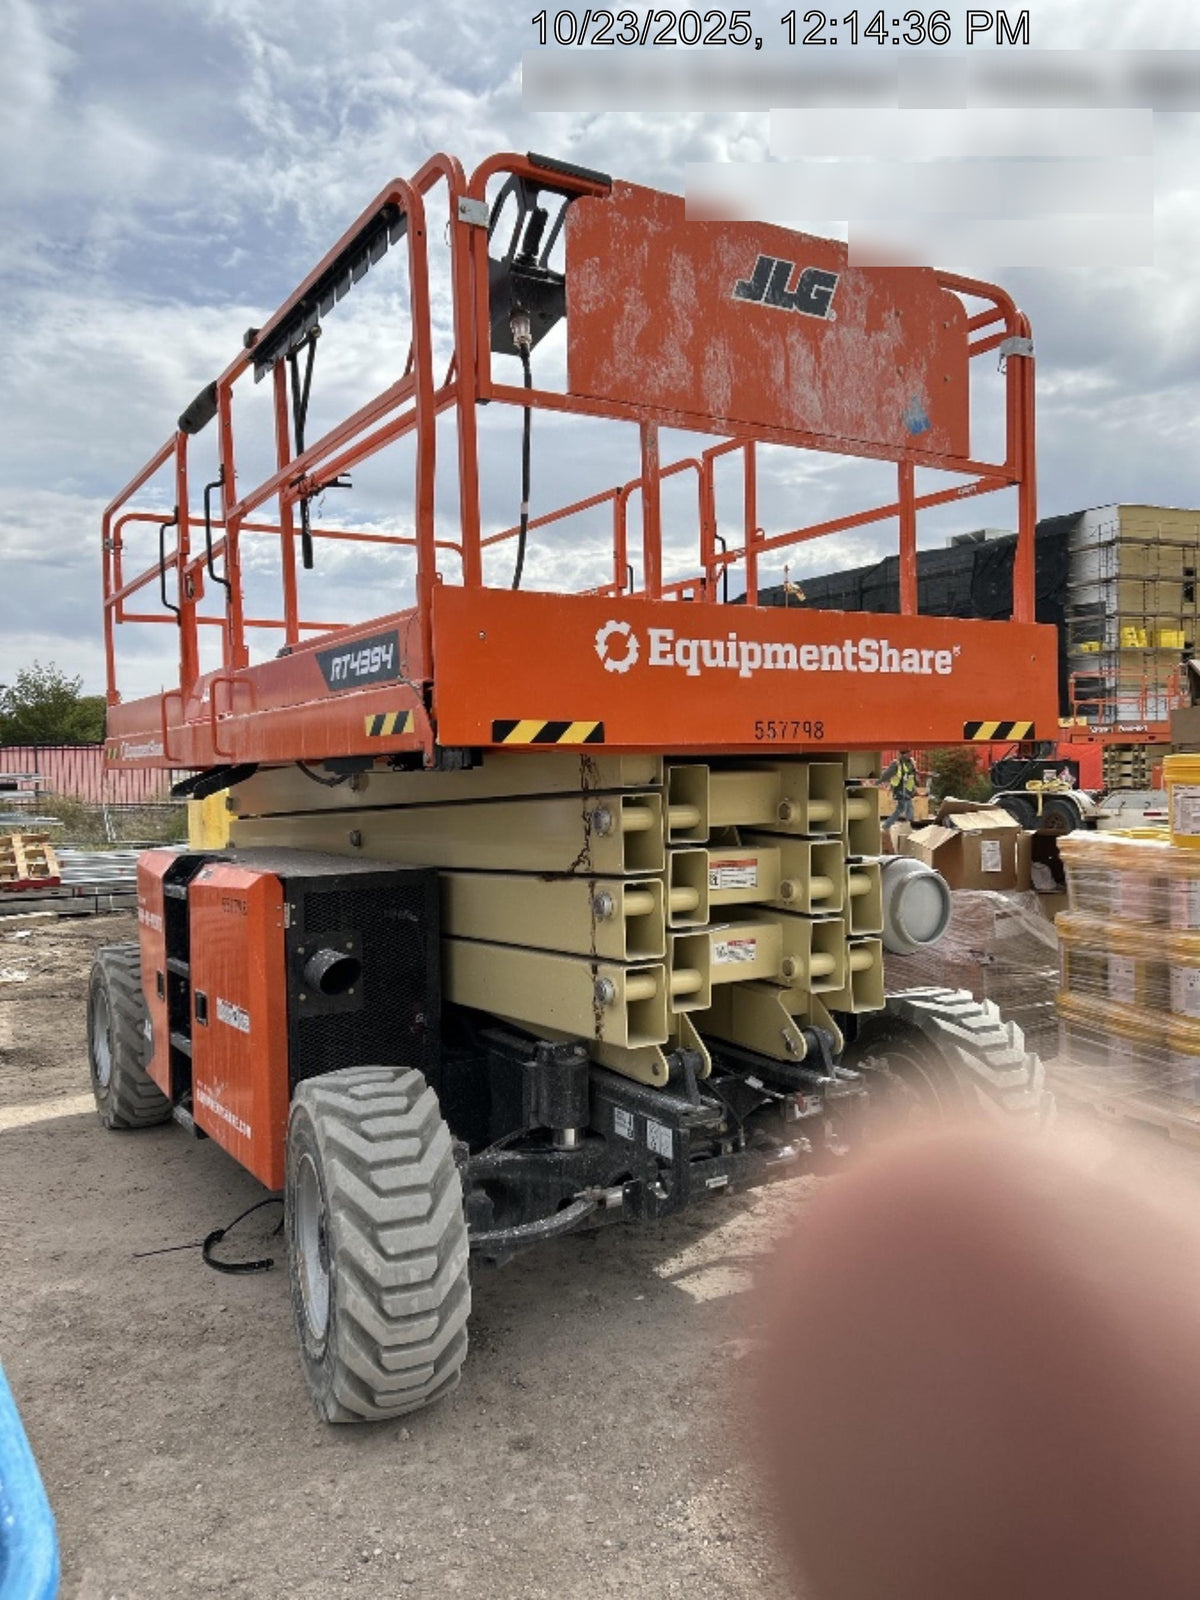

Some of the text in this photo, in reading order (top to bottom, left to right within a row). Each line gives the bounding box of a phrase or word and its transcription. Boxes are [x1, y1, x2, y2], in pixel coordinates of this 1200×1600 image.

[731, 254, 839, 320] JLG
[329, 643, 394, 682] RT4394
[647, 628, 953, 678] EquipmentShare
[754, 721, 825, 740] 557798
